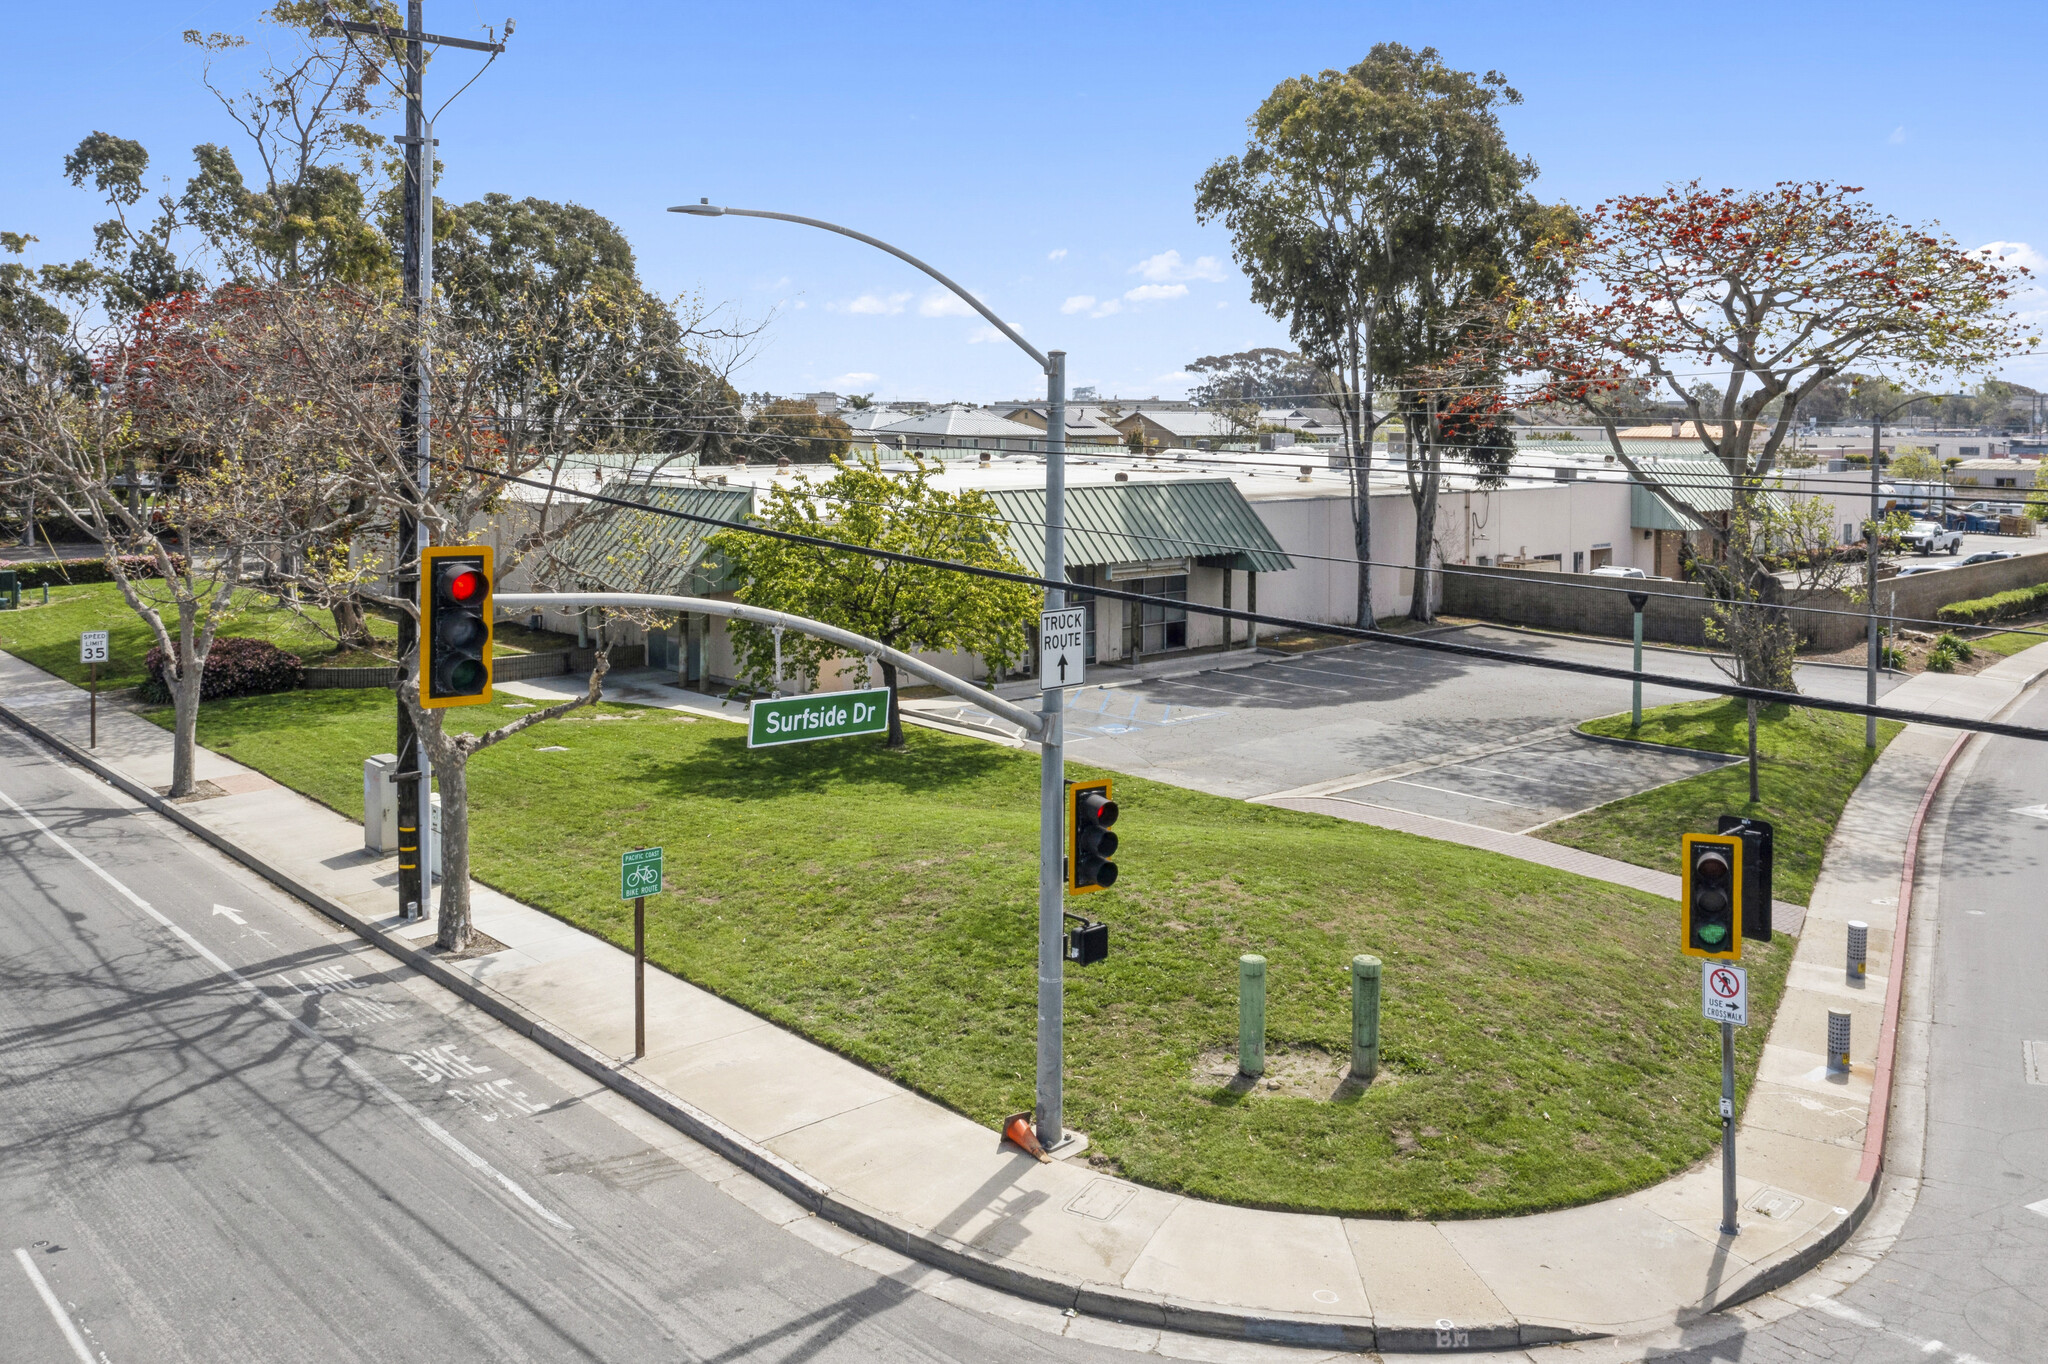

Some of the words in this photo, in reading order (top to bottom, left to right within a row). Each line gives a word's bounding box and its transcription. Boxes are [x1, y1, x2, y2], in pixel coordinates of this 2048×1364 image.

[1044, 613, 1082, 631] TRUCK
[1044, 632, 1081, 650] ROUTE
[84, 647, 105, 660] 35
[766, 705, 847, 734] Surfside
[853, 702, 876, 724] Dr
[625, 853, 644, 862] PACIFIC
[645, 850, 660, 859] COAST
[626, 888, 639, 897] BIKE
[641, 884, 658, 894] ROUTE
[277, 965, 370, 997] LANE
[1709, 998, 1723, 1008] USE
[1707, 1007, 1743, 1022] CROSSWALK
[396, 1044, 492, 1083] BIKE
